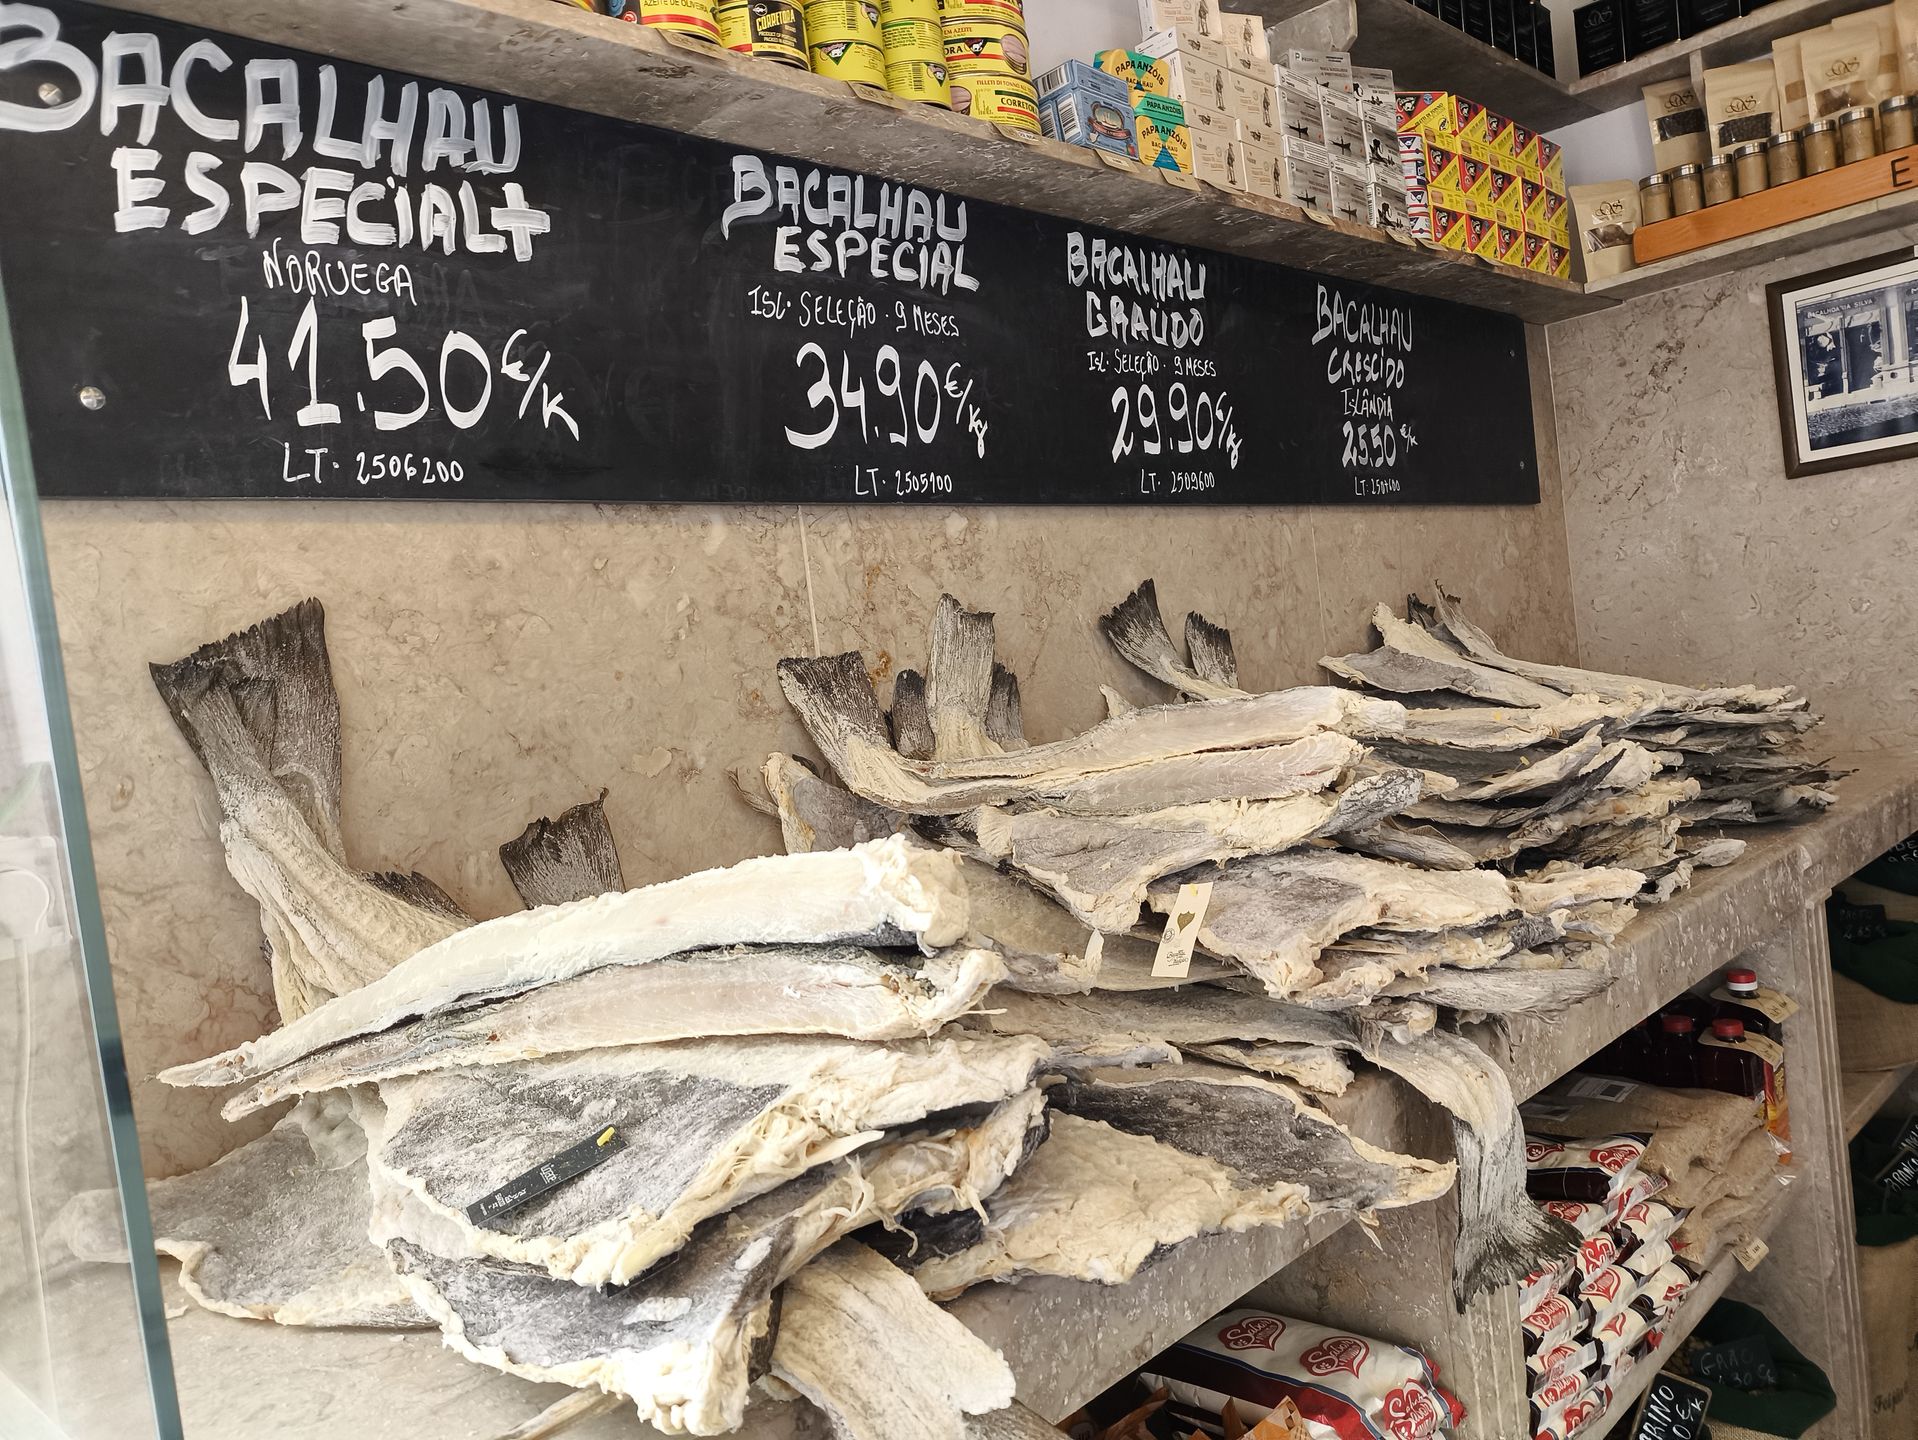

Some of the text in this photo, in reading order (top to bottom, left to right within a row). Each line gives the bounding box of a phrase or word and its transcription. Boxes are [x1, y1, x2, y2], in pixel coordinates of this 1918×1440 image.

[1115, 60, 1136, 76] PAPA
[0, 3, 521, 176] BACALHAU
[1146, 100, 1161, 110] PAPA
[1141, 125, 1160, 139] PAPA
[722, 154, 968, 242] BACALHAU
[263, 238, 417, 305] NORUEGA
[774, 226, 981, 296] ESPECIAL
[1066, 231, 1207, 302] BACALHAU
[799, 290, 877, 339] SELEÇÃO
[896, 301, 908, 332] 9
[913, 304, 960, 337] MESES
[1311, 281, 1414, 352] BACALHAU
[1853, 298, 1874, 308] SILVA
[1114, 348, 1160, 382] SELEÇÃO
[1185, 359, 1217, 377] MESES
[1327, 347, 1405, 389] CRESCIDO
[1340, 387, 1394, 422] ISLÂNDIA
[356, 452, 465, 484] 2506200
[1226, 1318, 1274, 1350] Sabor
[1308, 1339, 1355, 1377] Sabor
